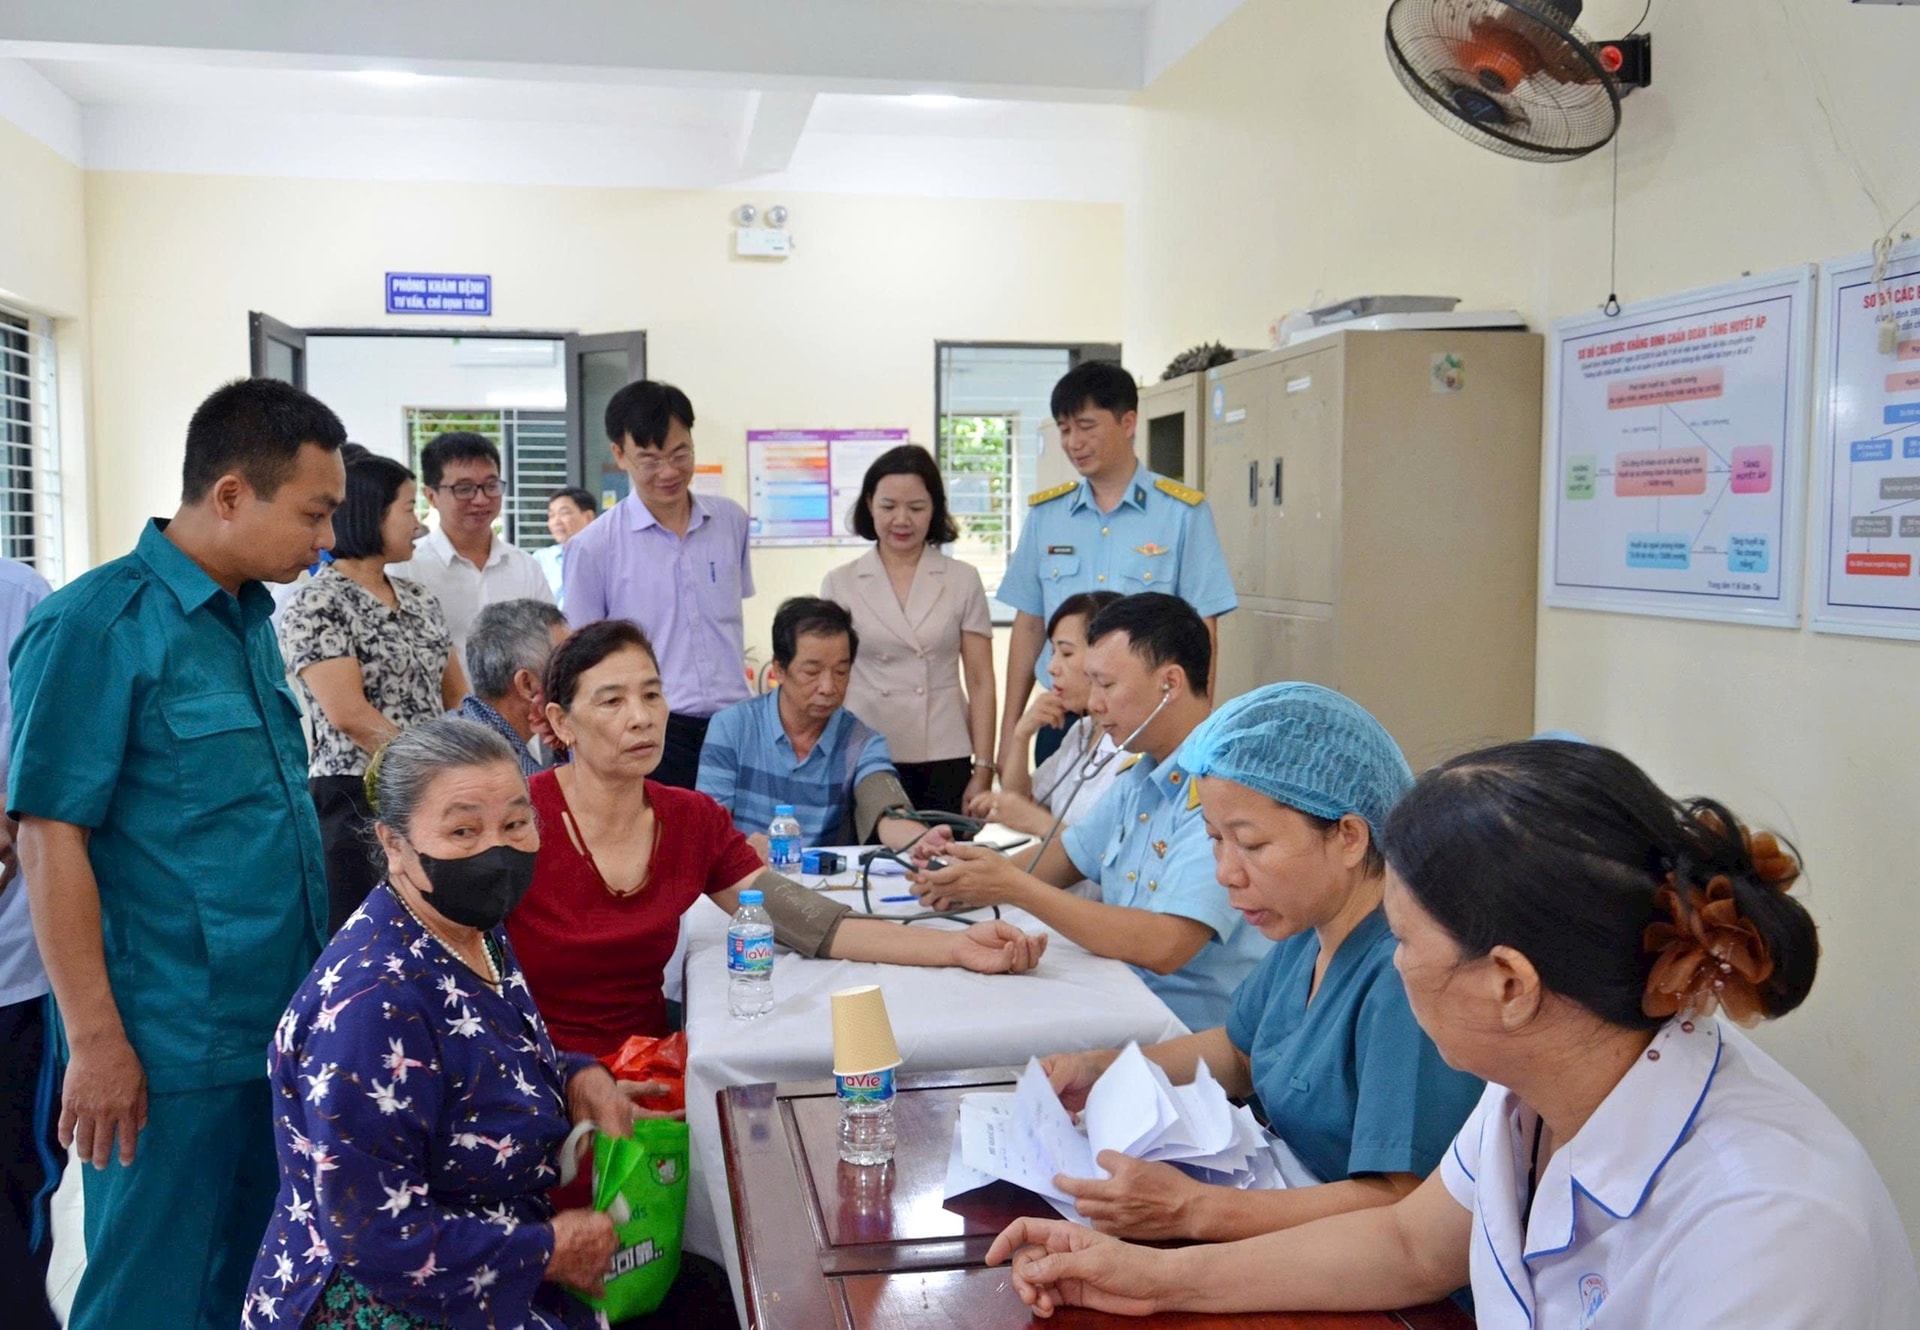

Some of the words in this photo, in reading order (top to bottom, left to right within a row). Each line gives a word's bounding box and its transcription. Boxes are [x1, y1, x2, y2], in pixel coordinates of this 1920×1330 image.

[392, 276, 426, 292] PHÒNG
[427, 278, 457, 294] KHÁM
[458, 280, 485, 297] BỆNH
[1863, 293, 1877, 309] SƠ
[1894, 286, 1914, 303] CÁC
[1755, 313, 1767, 329] ÁP
